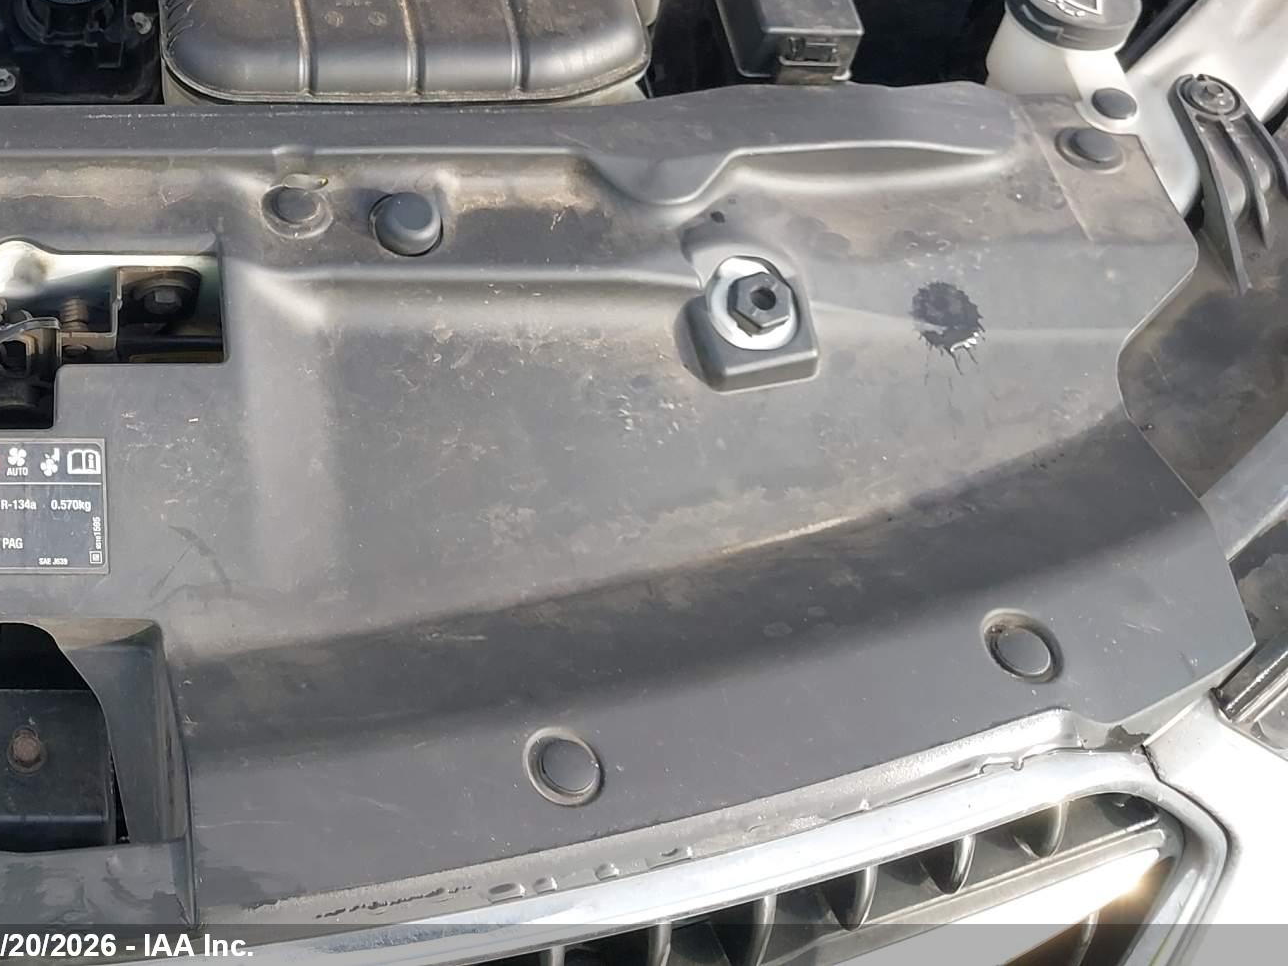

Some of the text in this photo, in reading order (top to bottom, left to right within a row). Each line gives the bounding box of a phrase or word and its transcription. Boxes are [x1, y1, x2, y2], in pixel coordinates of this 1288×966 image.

[6, 467, 29, 477] AUTO
[0, 499, 92, 513] R-134a 0.570kg
[2, 537, 24, 550] PAG
